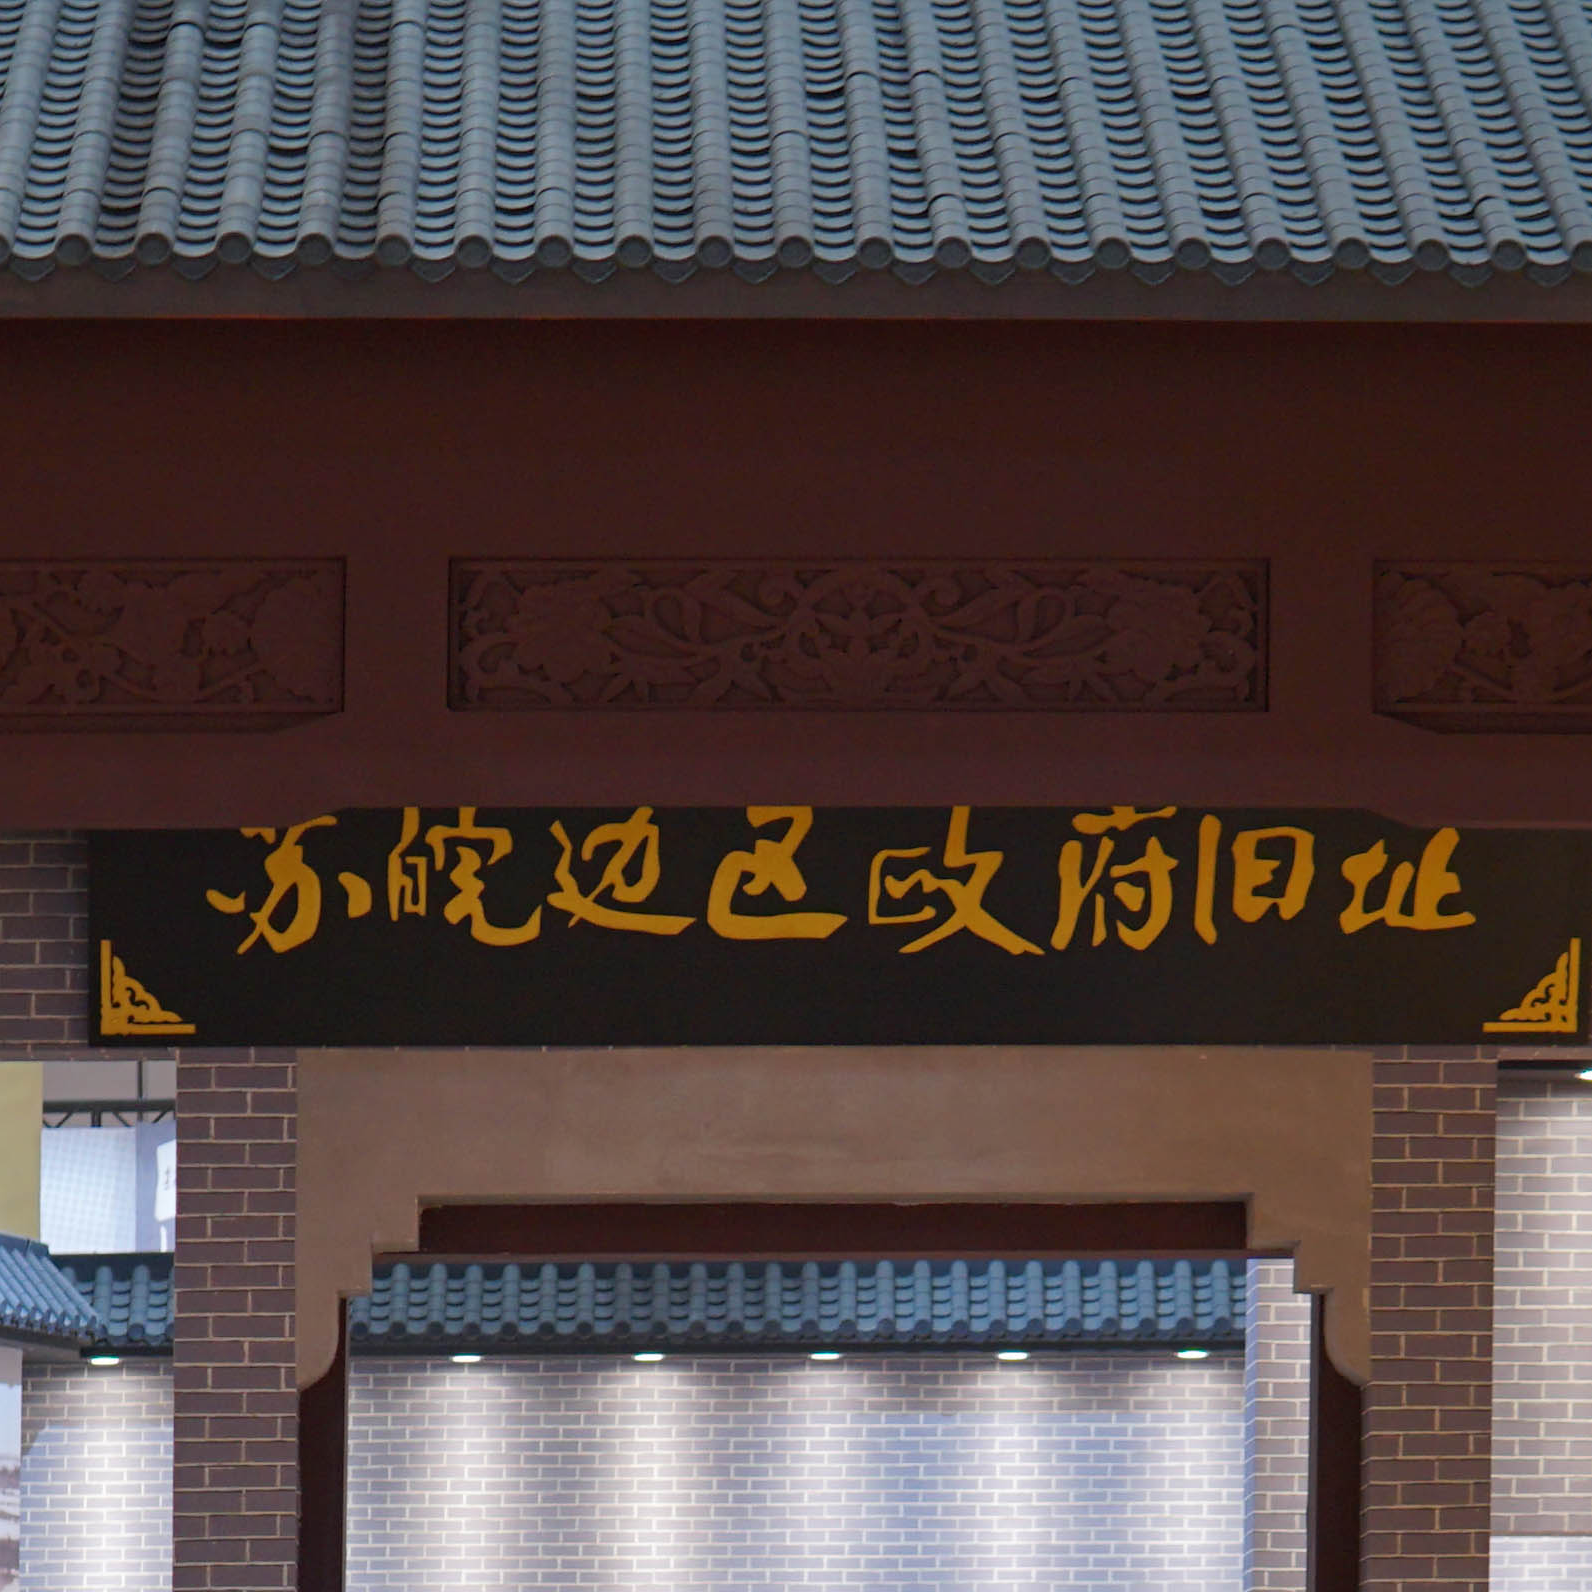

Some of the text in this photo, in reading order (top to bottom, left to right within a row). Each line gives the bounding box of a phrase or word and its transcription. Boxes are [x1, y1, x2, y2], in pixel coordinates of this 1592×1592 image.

[205, 806, 1476, 954] 苏皖边区政府旧址
